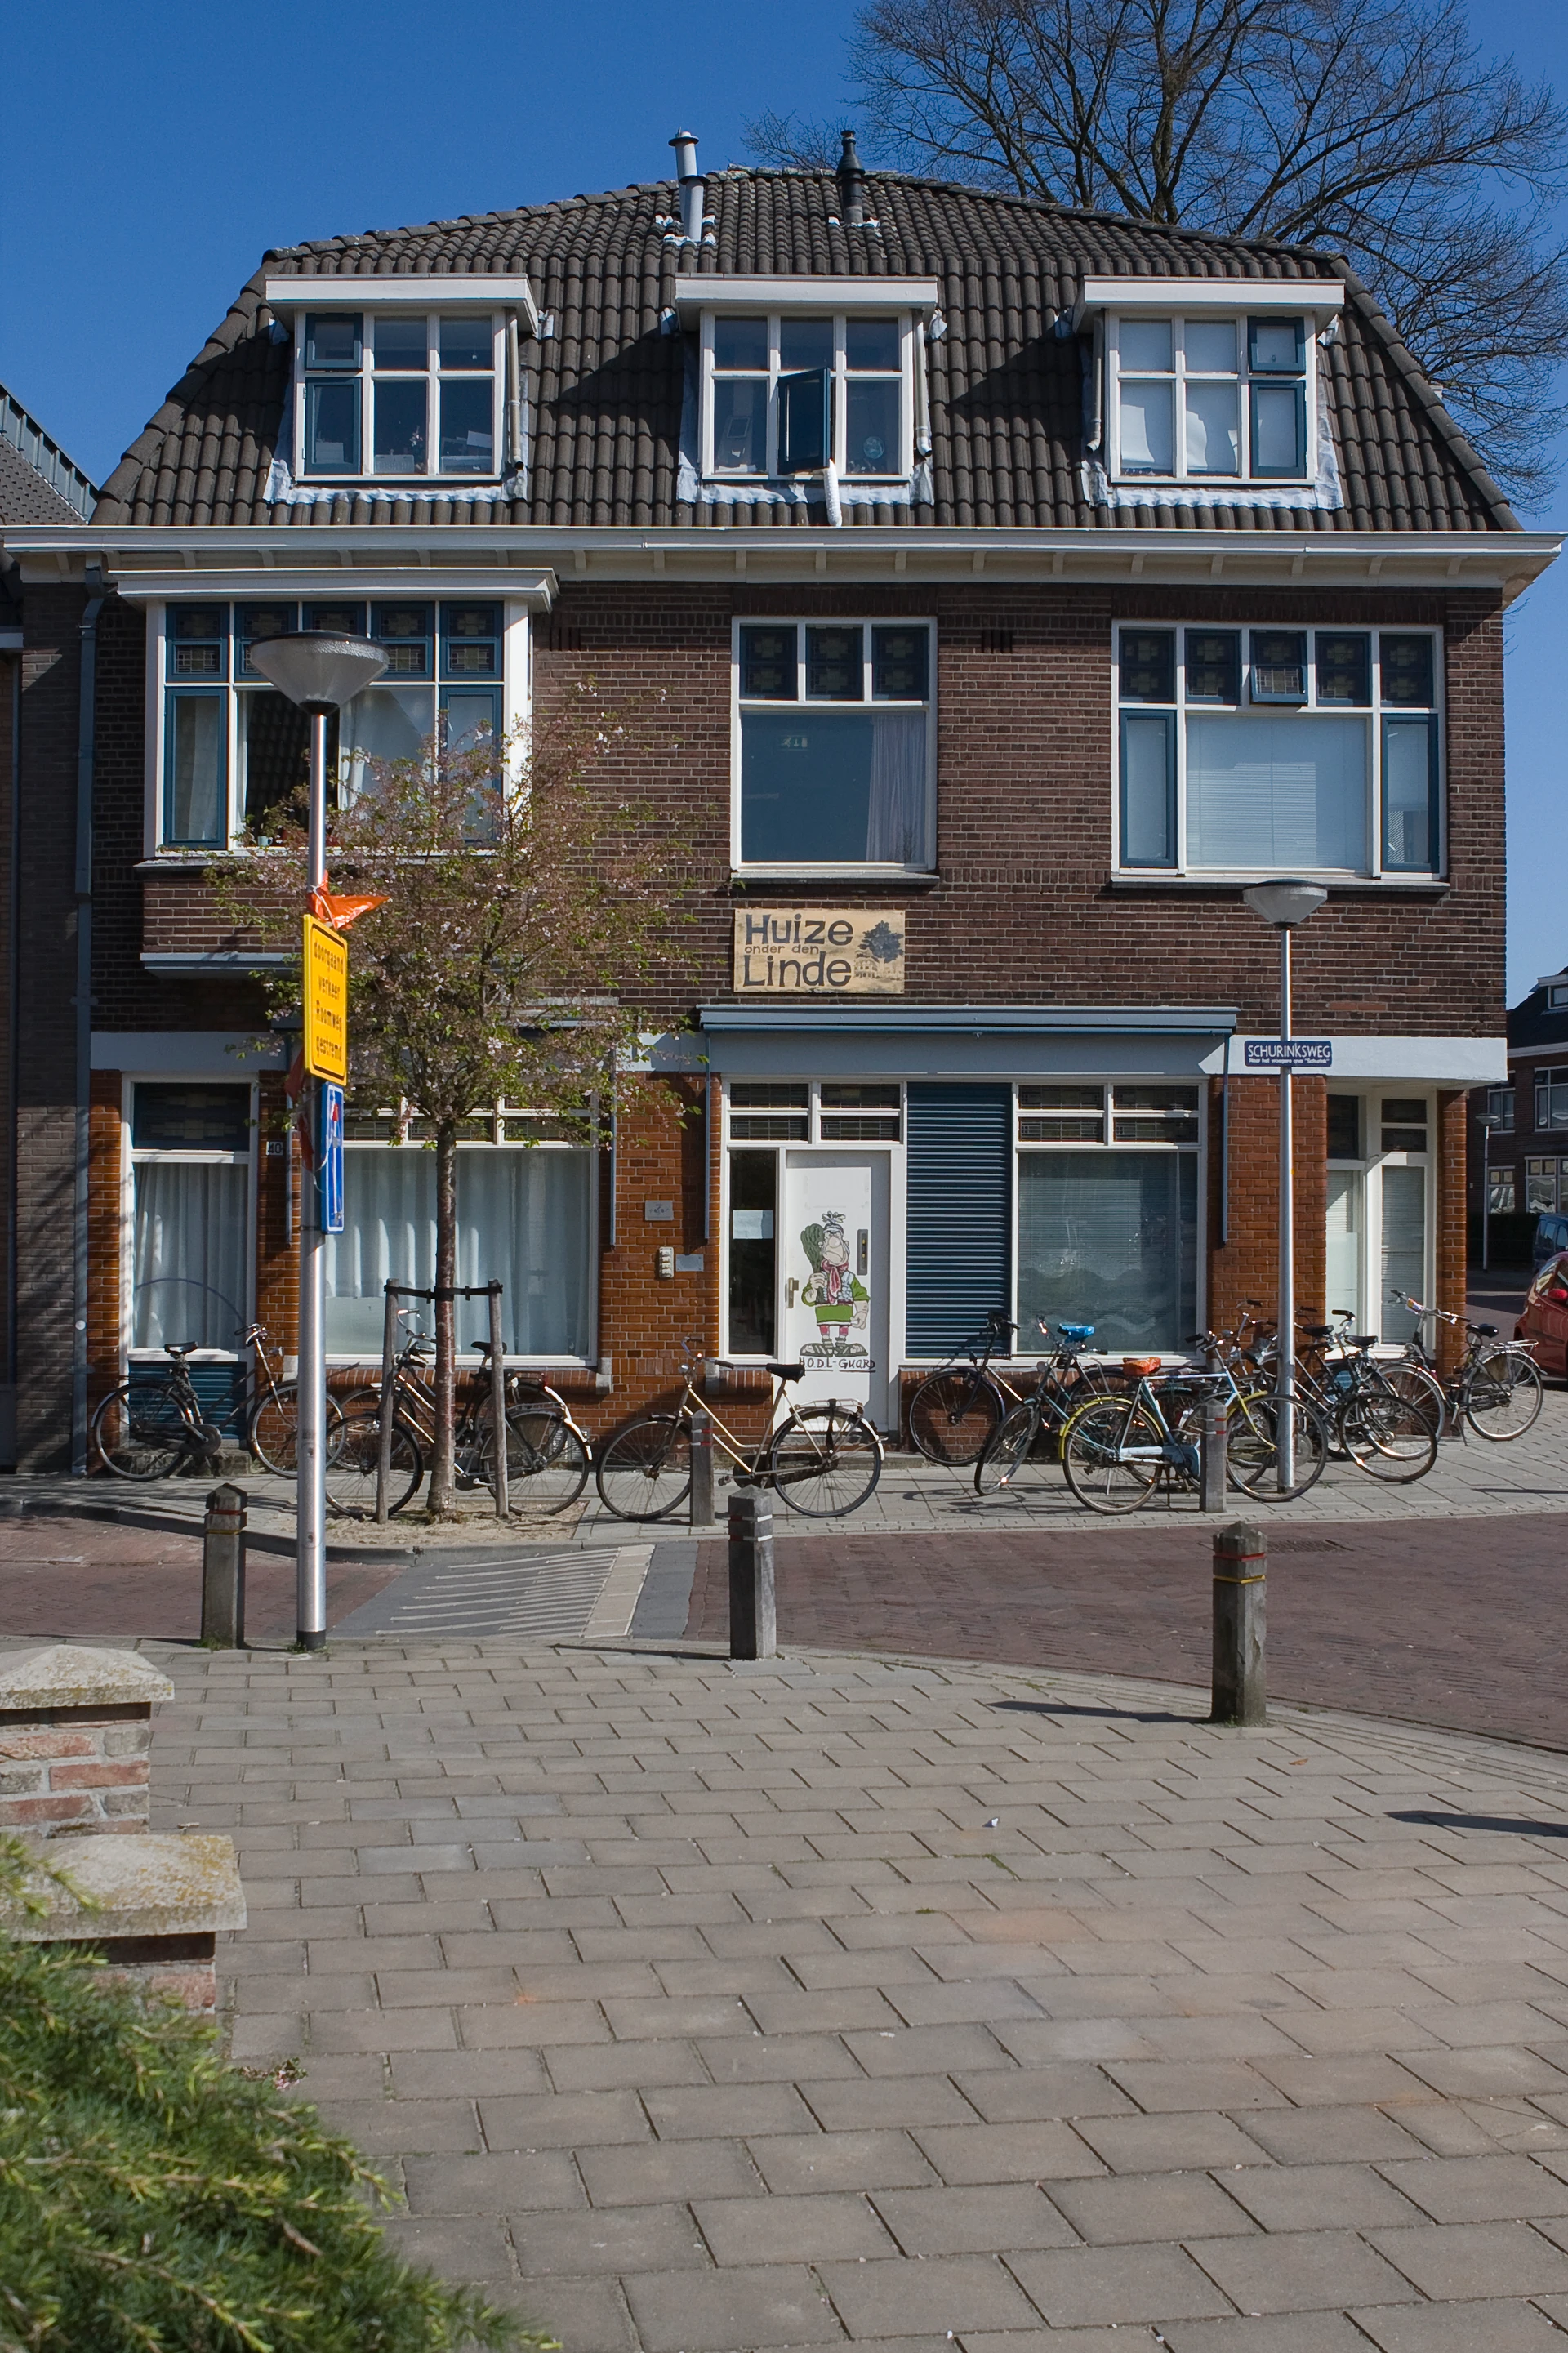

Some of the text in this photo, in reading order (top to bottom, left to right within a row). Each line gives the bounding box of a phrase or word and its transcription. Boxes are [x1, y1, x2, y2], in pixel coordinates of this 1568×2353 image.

[746, 913, 853, 946] Huize
[314, 938, 344, 974] doorgaand
[744, 943, 819, 954] onder den
[743, 951, 852, 987] Linde
[318, 974, 341, 1000] verkeer
[316, 999, 342, 1037] Roomweg
[316, 1035, 342, 1062] gestremd
[1248, 1042, 1330, 1058] SCHURINKSWEG
[267, 1143, 283, 1154] 40
